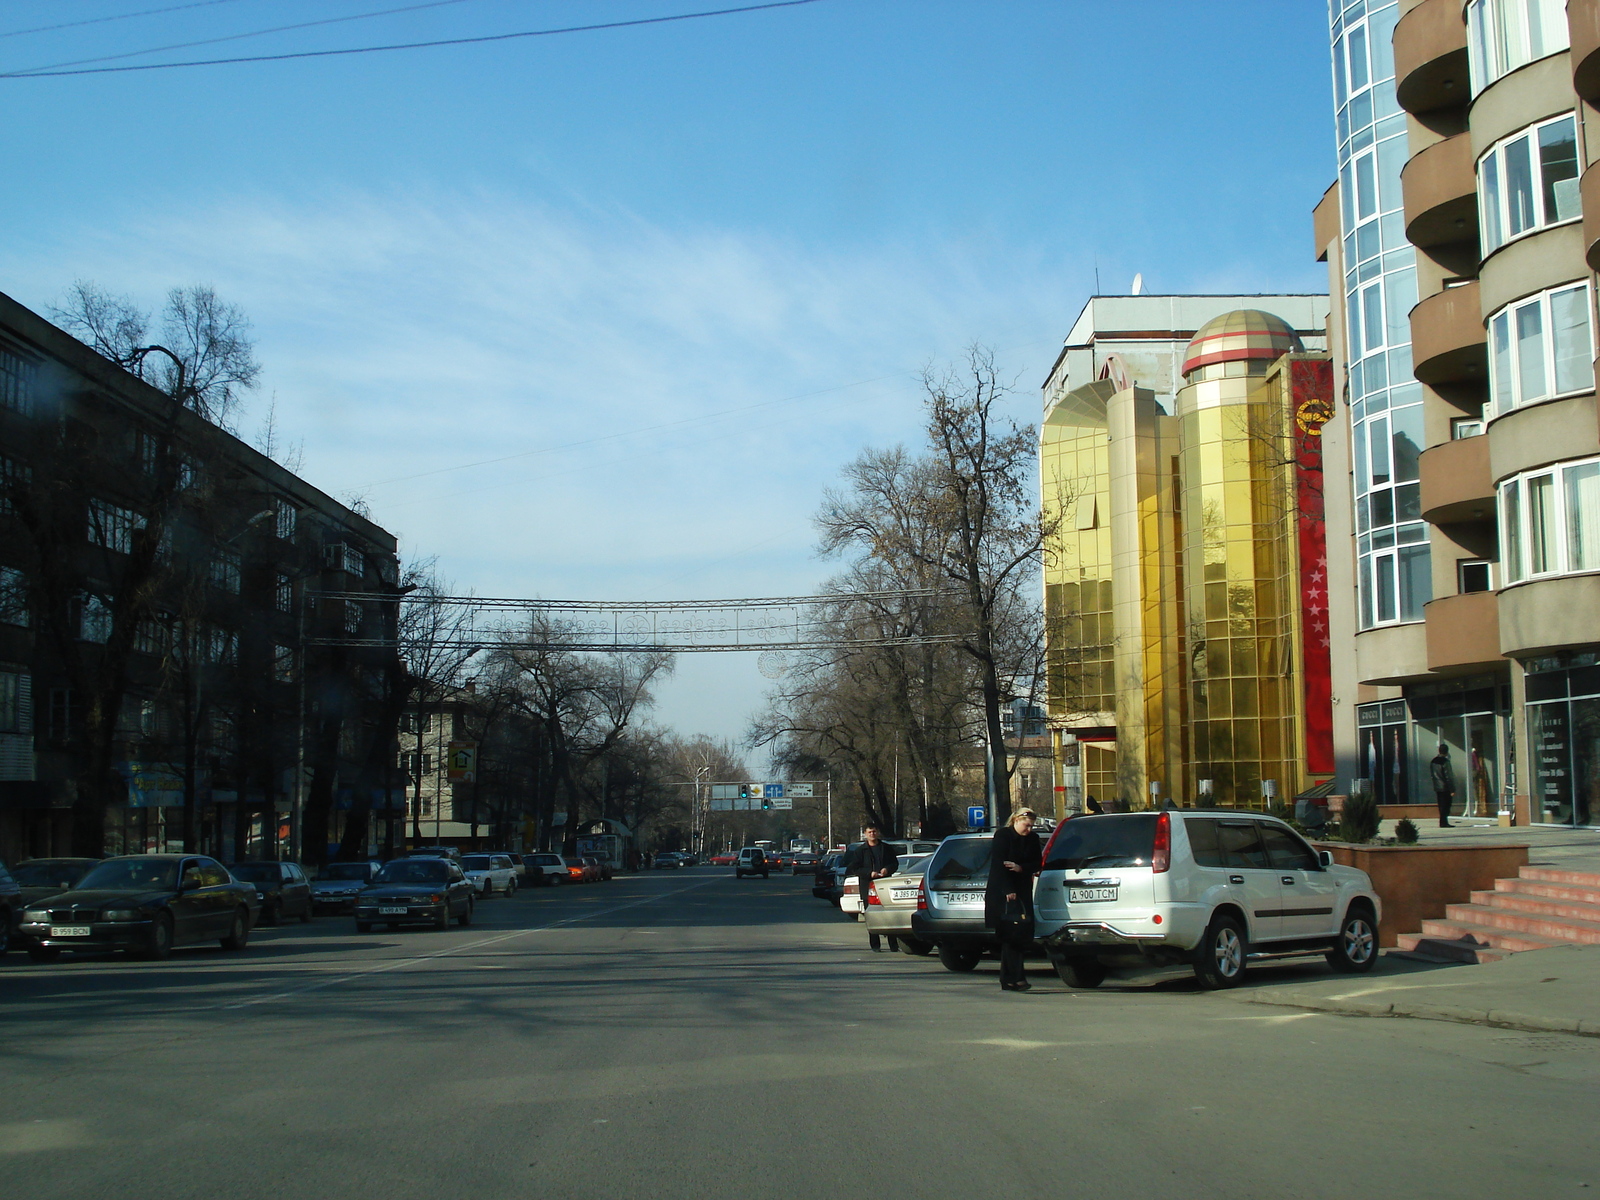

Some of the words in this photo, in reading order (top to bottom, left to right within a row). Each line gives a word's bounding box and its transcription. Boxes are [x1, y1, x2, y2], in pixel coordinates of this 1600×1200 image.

[1385, 707, 1403, 717] GUCCI
[973, 809, 985, 825] P
[950, 893, 955, 902] A
[956, 893, 969, 902] 415
[1072, 891, 1078, 899] A
[1080, 890, 1094, 899] 900
[1096, 889, 1115, 899] TCM
[59, 928, 72, 936] 959
